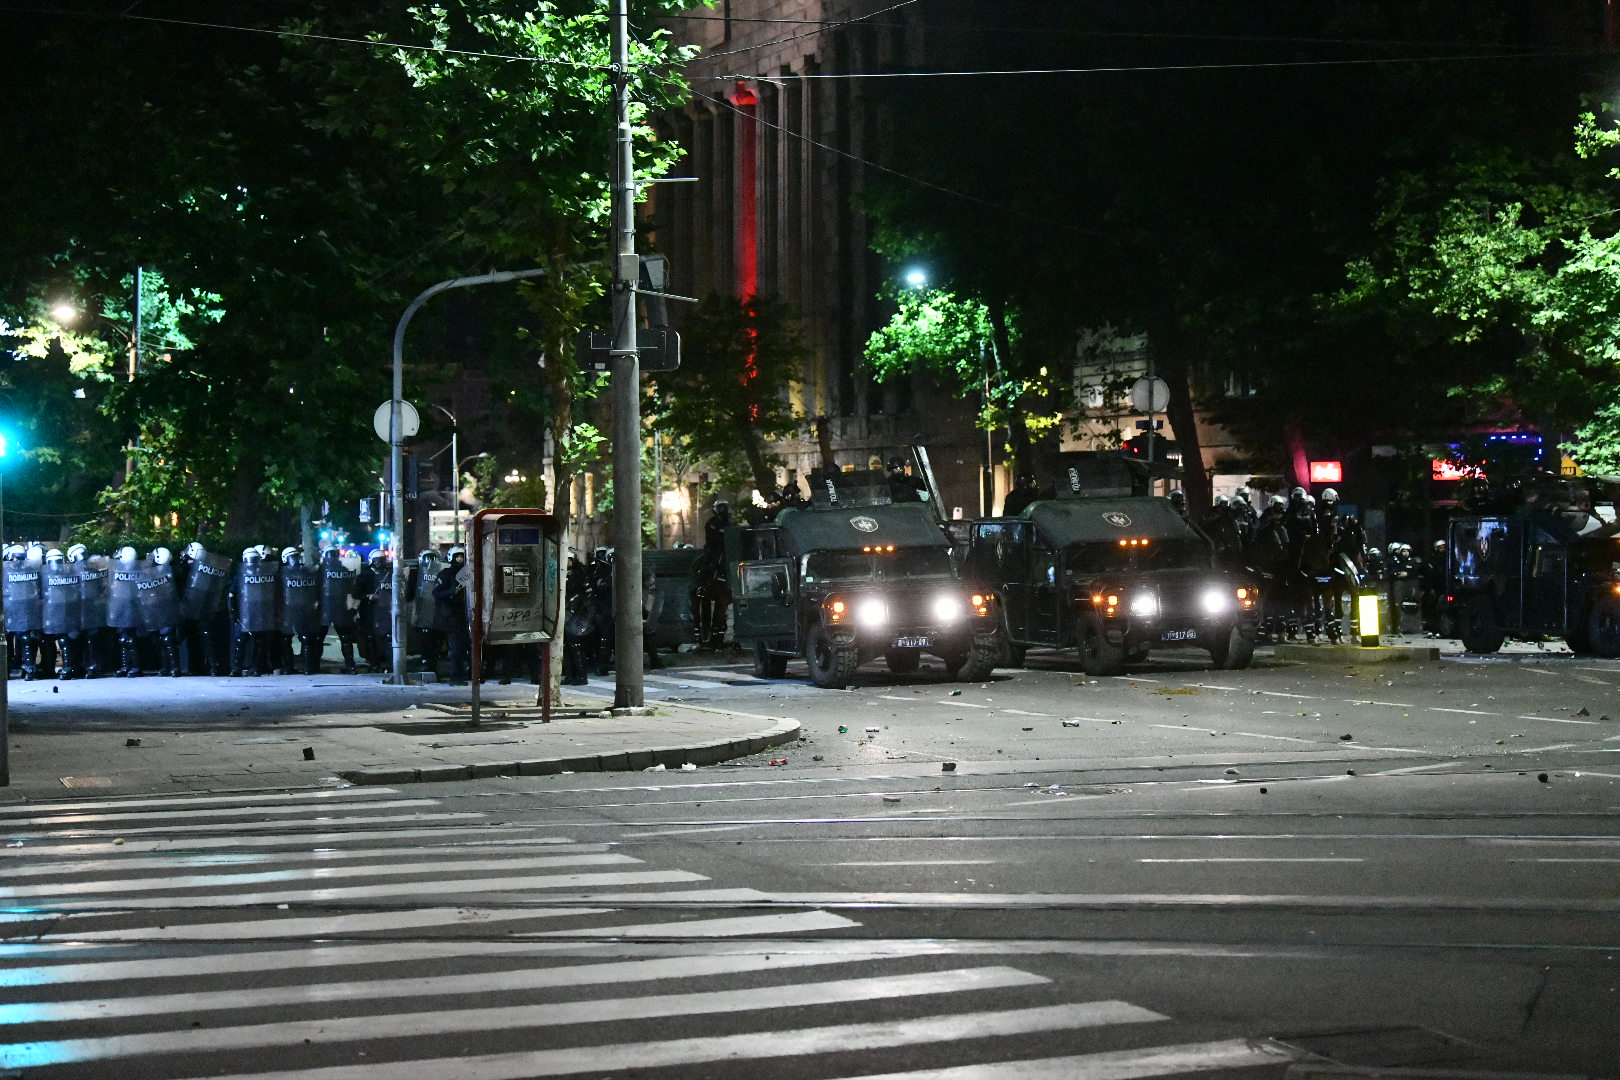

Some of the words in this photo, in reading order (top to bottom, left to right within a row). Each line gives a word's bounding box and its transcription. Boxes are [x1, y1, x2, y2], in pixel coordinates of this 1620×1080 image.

[198, 564, 226, 577] POLICIJA
[137, 577, 169, 590] POLICIJA
[244, 575, 275, 584] POLICIJA
[287, 579, 317, 588] POLICIJA
